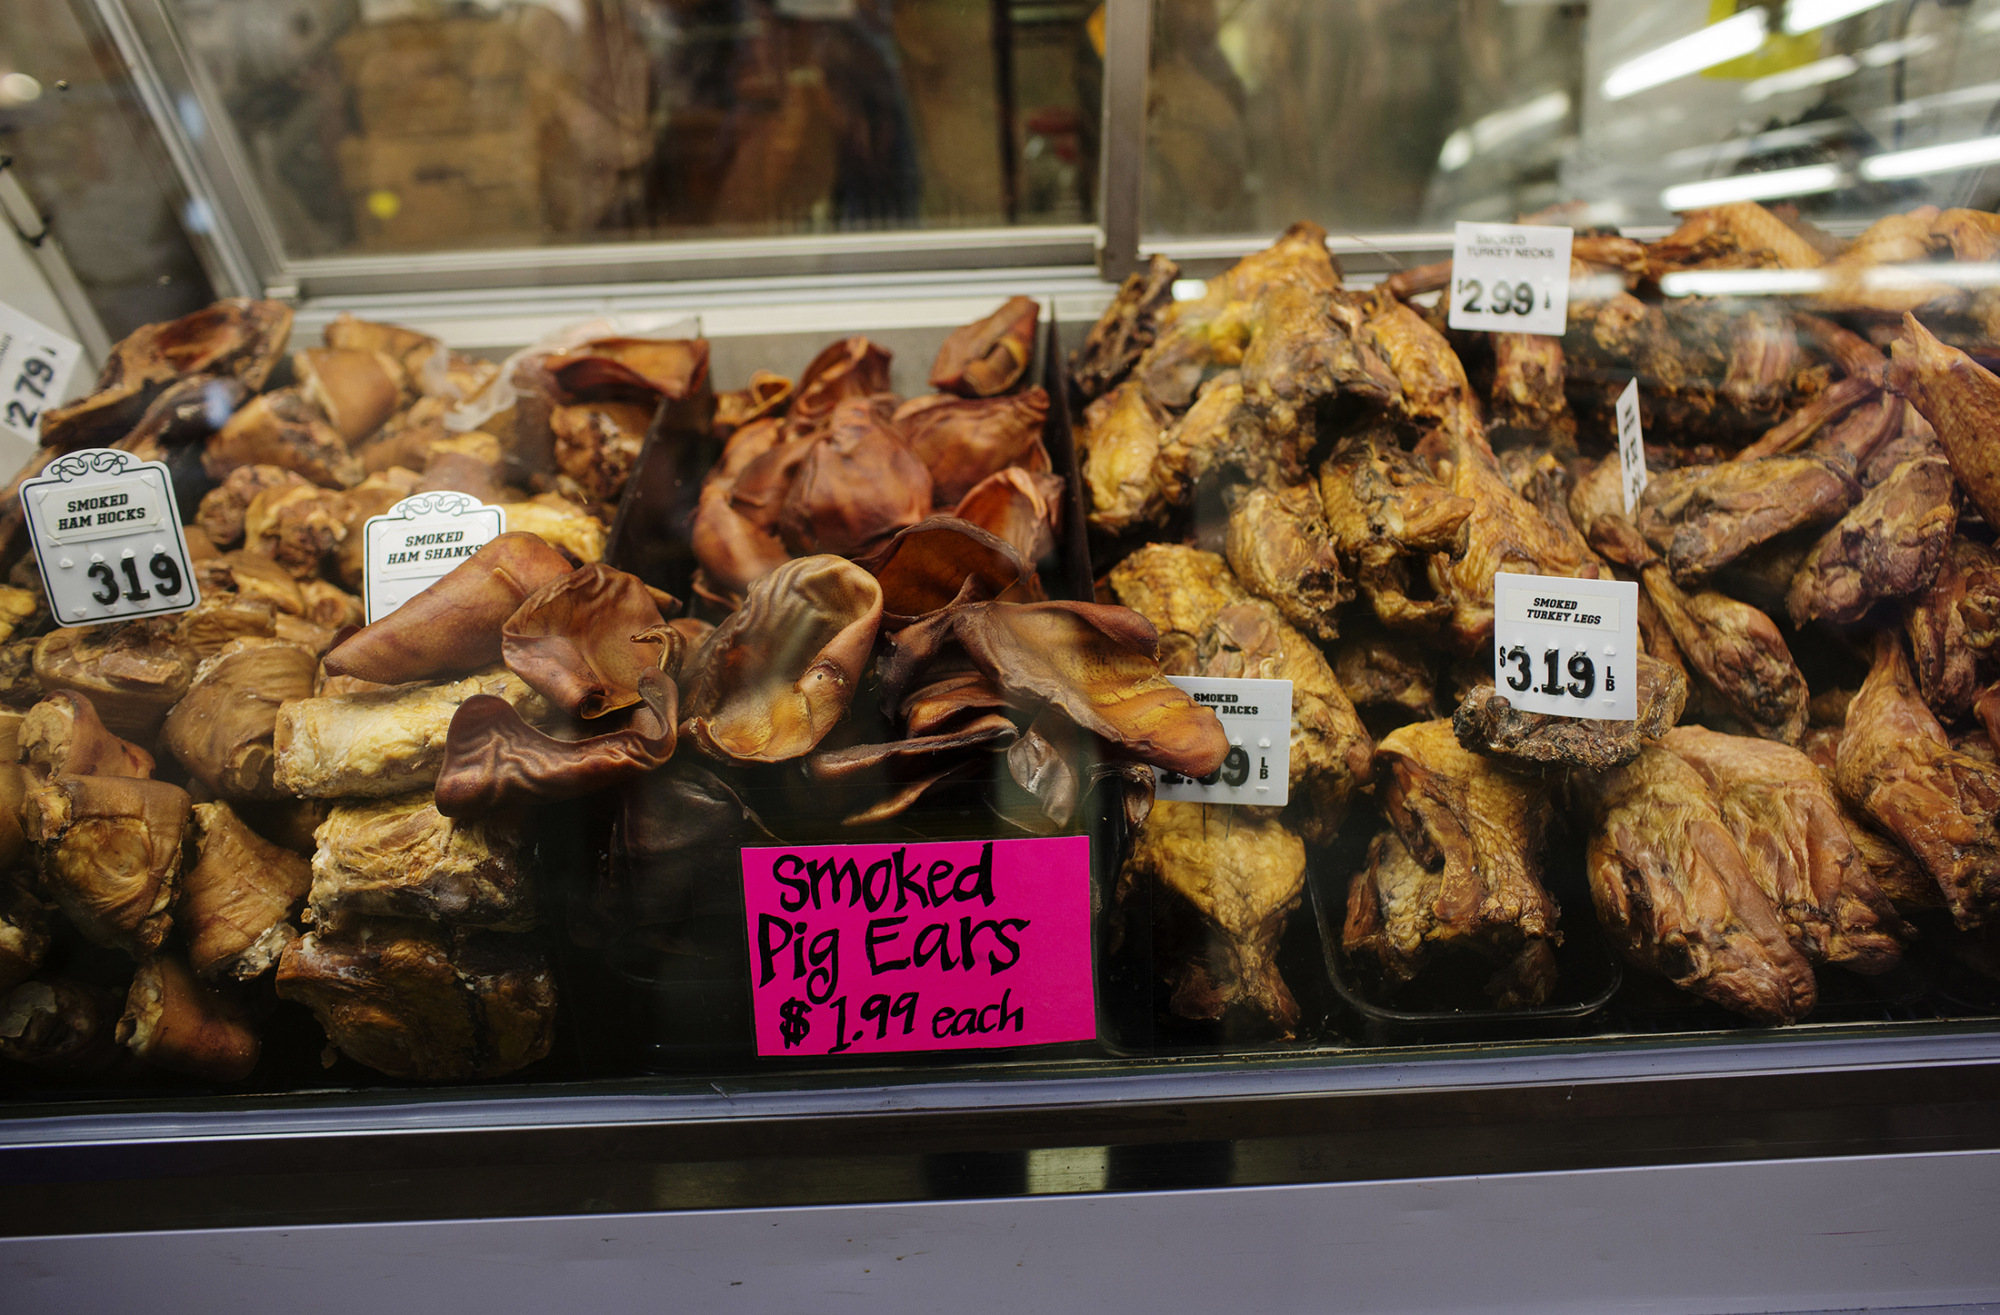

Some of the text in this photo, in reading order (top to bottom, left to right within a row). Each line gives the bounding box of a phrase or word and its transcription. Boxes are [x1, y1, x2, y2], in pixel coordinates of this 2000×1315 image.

[1467, 246, 1555, 259] TURKEY NECKS
[67, 493, 129, 513] SMOKED
[58, 507, 146, 531] HAM HOCKS
[405, 531, 464, 547] SMOKED
[387, 551, 420, 565] HAM
[87, 553, 182, 605] 319
[1533, 597, 1578, 610] SMOKED
[1527, 609, 1602, 625] TURKEY LEGS
[1499, 645, 1596, 699] $3.19
[1193, 693, 1239, 703] SMOKED
[1222, 705, 1259, 715] BACKS
[772, 841, 996, 913] Smoked
[757, 913, 1031, 1005] Pig Ears
[932, 988, 1024, 1038] each
